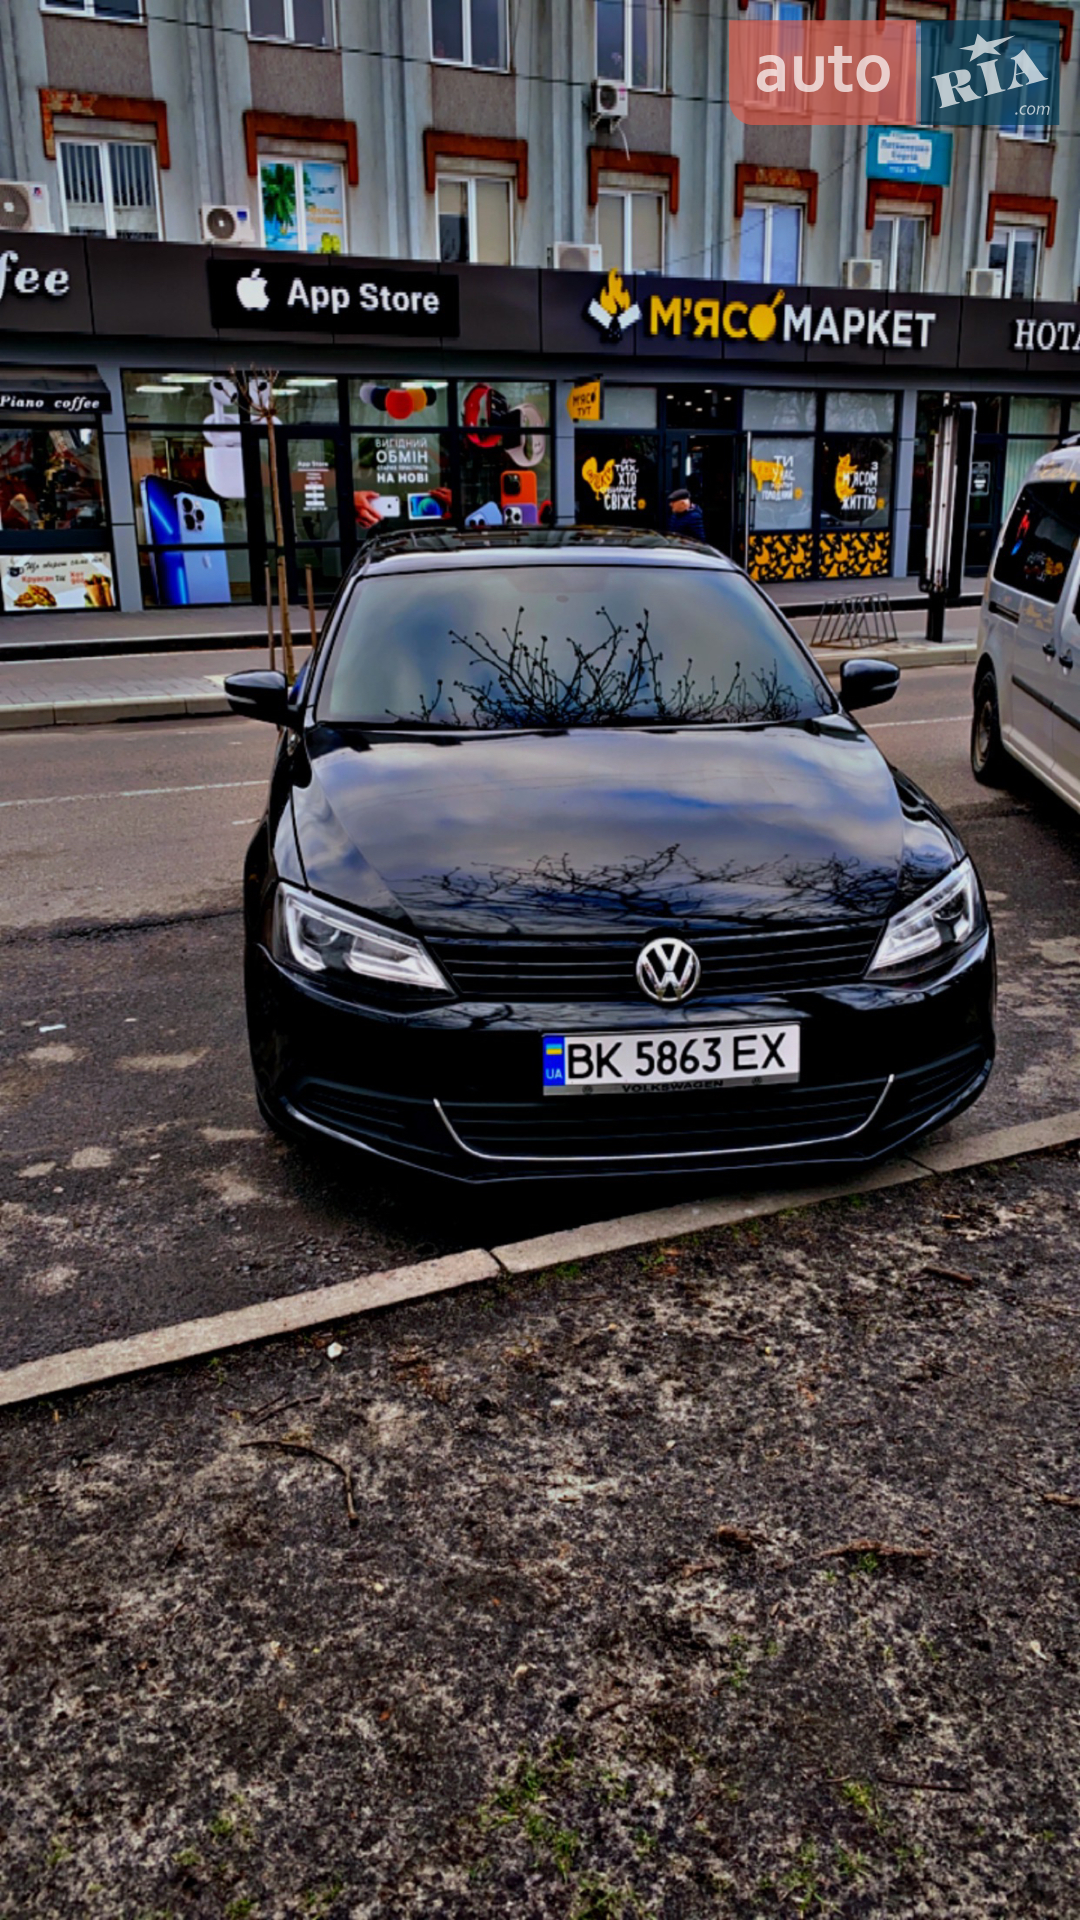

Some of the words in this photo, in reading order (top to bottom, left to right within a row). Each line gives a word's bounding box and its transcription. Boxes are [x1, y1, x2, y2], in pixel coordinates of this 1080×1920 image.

[287, 277, 350, 314] App
[359, 283, 440, 314] Store
[0, 395, 44, 408] Piano
[54, 396, 99, 412] coffee
[375, 437, 428, 448] ВИГІДНИЙ
[376, 449, 428, 464] ОБМІН
[774, 455, 794, 467] ТИ
[377, 472, 395, 483] НА
[398, 472, 428, 483] НОВІ
[618, 472, 637, 485] ХТО
[604, 493, 637, 510] СВІЖЕ
[841, 494, 877, 510] ЖИТТЮ
[568, 1042, 623, 1079] BK
[635, 1037, 722, 1077] 5863
[733, 1033, 786, 1071] EX
[545, 1068, 563, 1079] UA
[622, 1080, 724, 1093] VOLKSWAGEN
